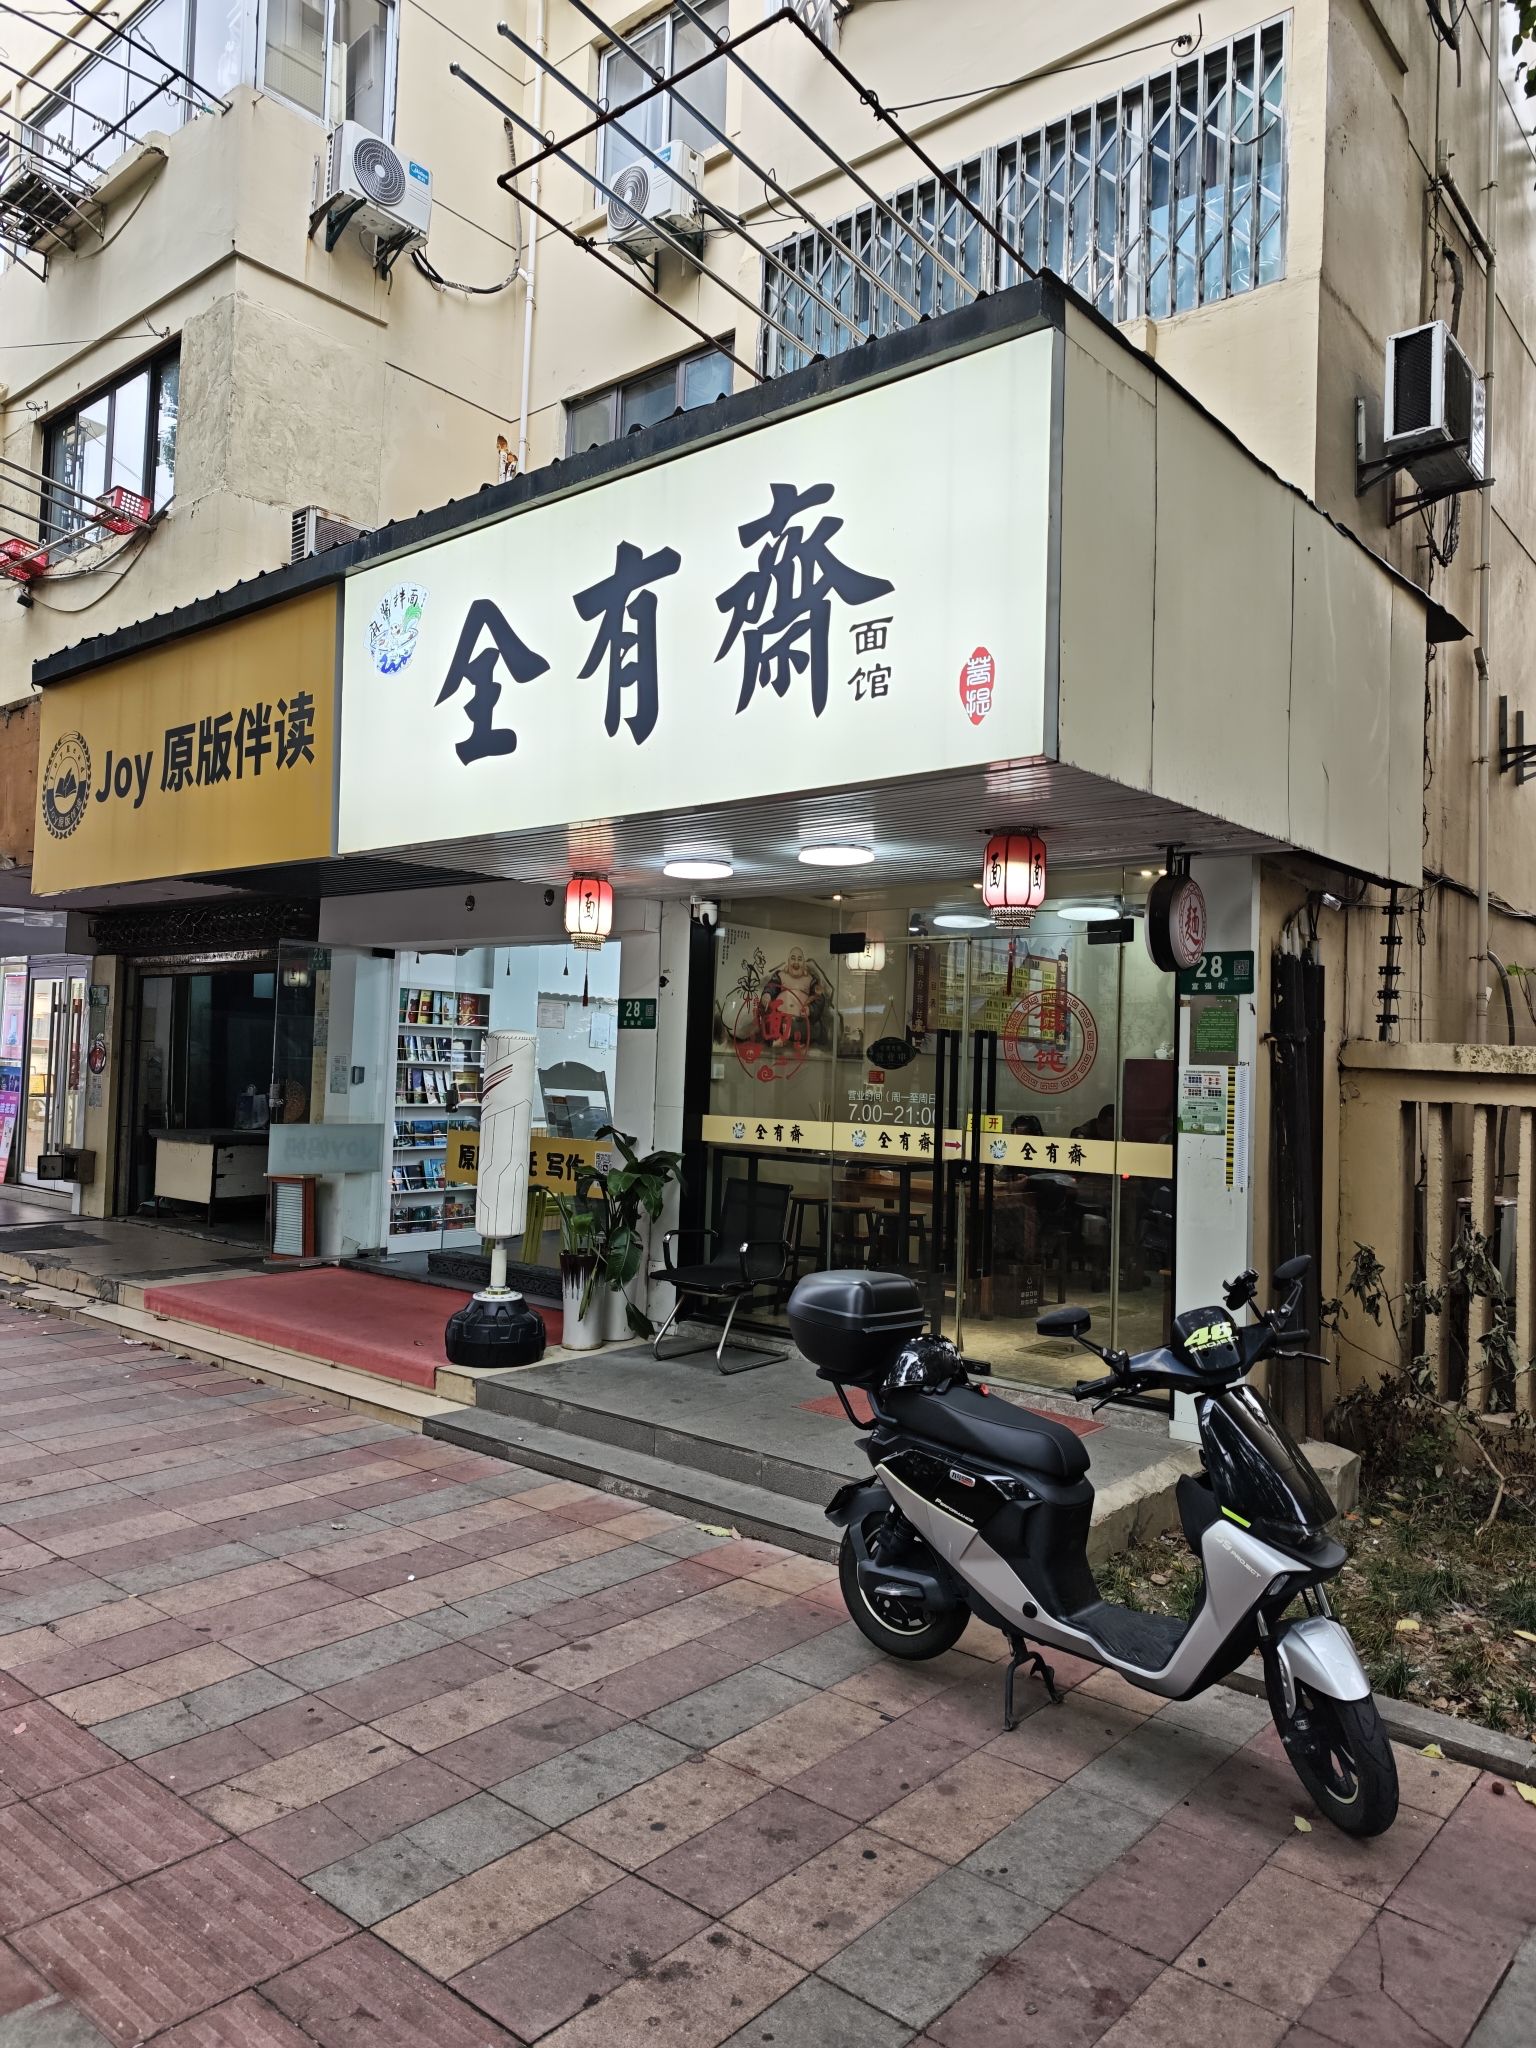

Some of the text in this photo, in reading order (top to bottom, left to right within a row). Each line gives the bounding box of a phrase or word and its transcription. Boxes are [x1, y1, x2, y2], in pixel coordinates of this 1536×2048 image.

[434, 482, 896, 766] 全有齋
[847, 615, 894, 702] 面馆
[965, 655, 992, 717] 菩提
[95, 690, 316, 810] Joy 原版伴读
[1196, 956, 1223, 977] 28
[625, 1001, 640, 1017] 28
[848, 1103, 936, 1126] 7.00-21:0
[988, 1117, 999, 1129] 开
